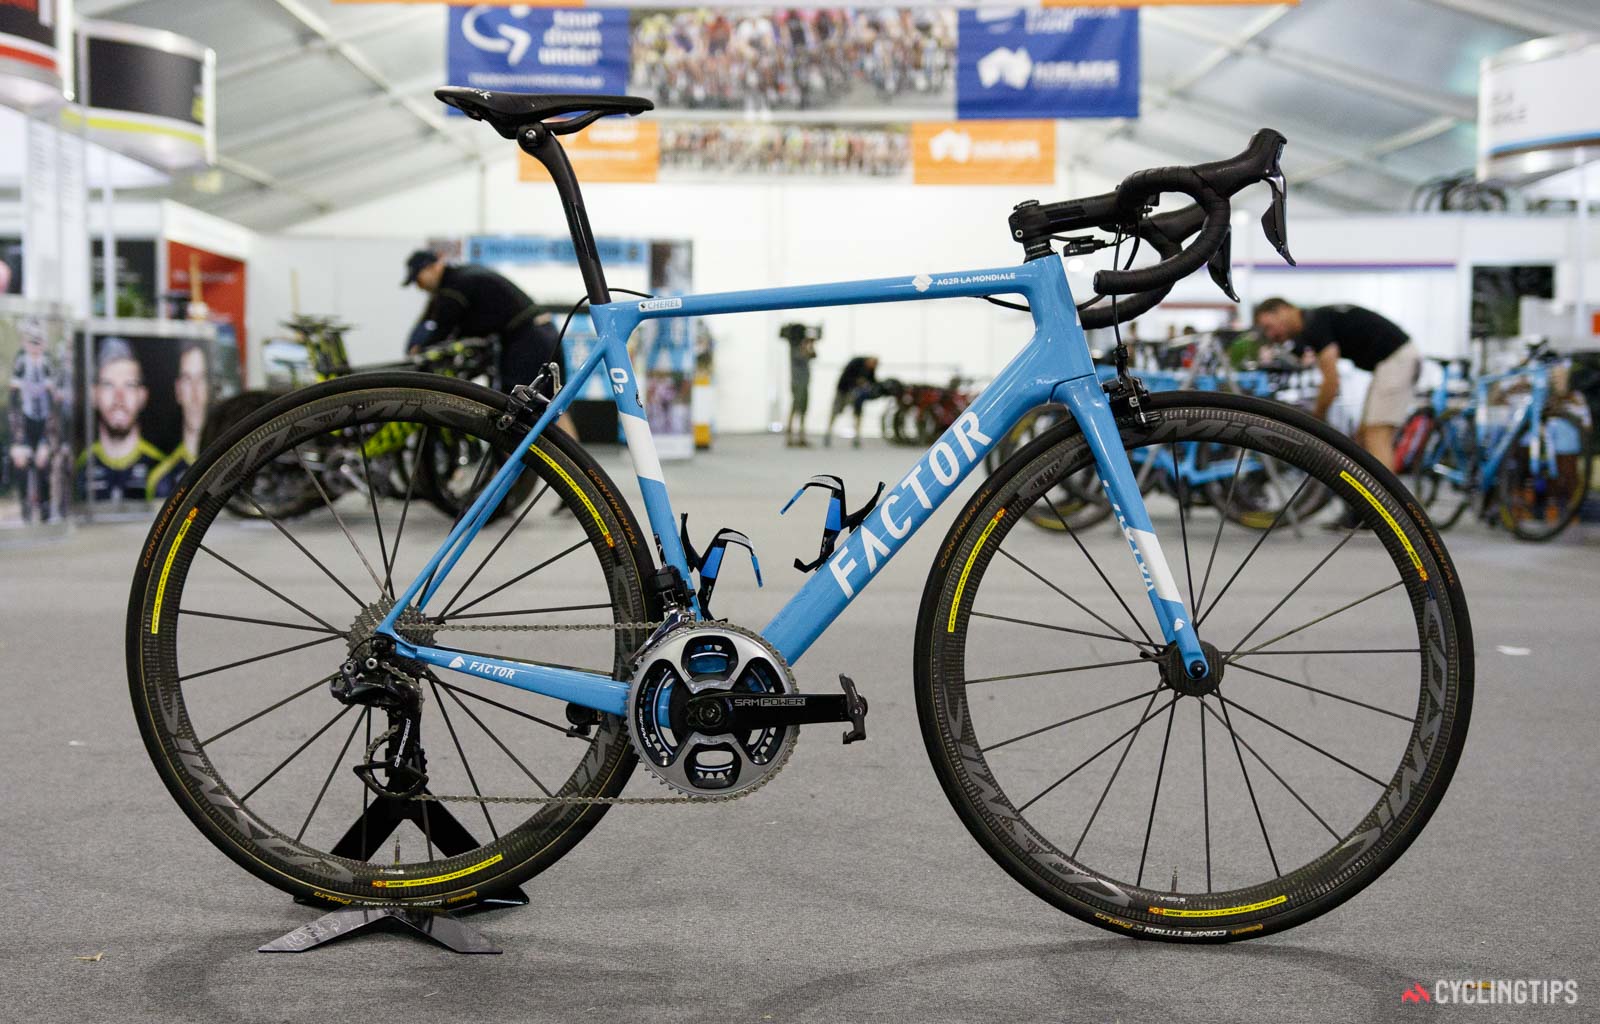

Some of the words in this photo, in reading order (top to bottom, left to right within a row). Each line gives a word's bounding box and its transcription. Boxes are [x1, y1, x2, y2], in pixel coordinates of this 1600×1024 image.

[647, 299, 681, 310] CHEREL
[936, 277, 959, 287] AG2R
[960, 276, 972, 285] LA
[972, 272, 1016, 283] MONDIALE
[141, 484, 187, 568] CONTINENTAL
[586, 467, 639, 549] CONTINENTAL
[829, 411, 992, 599] FACTOR
[937, 486, 993, 568] CONTINENTAL
[1404, 500, 1456, 586] CONTINENTAL
[469, 661, 516, 680] FACTOR
[1143, 925, 1227, 937] COMPETITION
